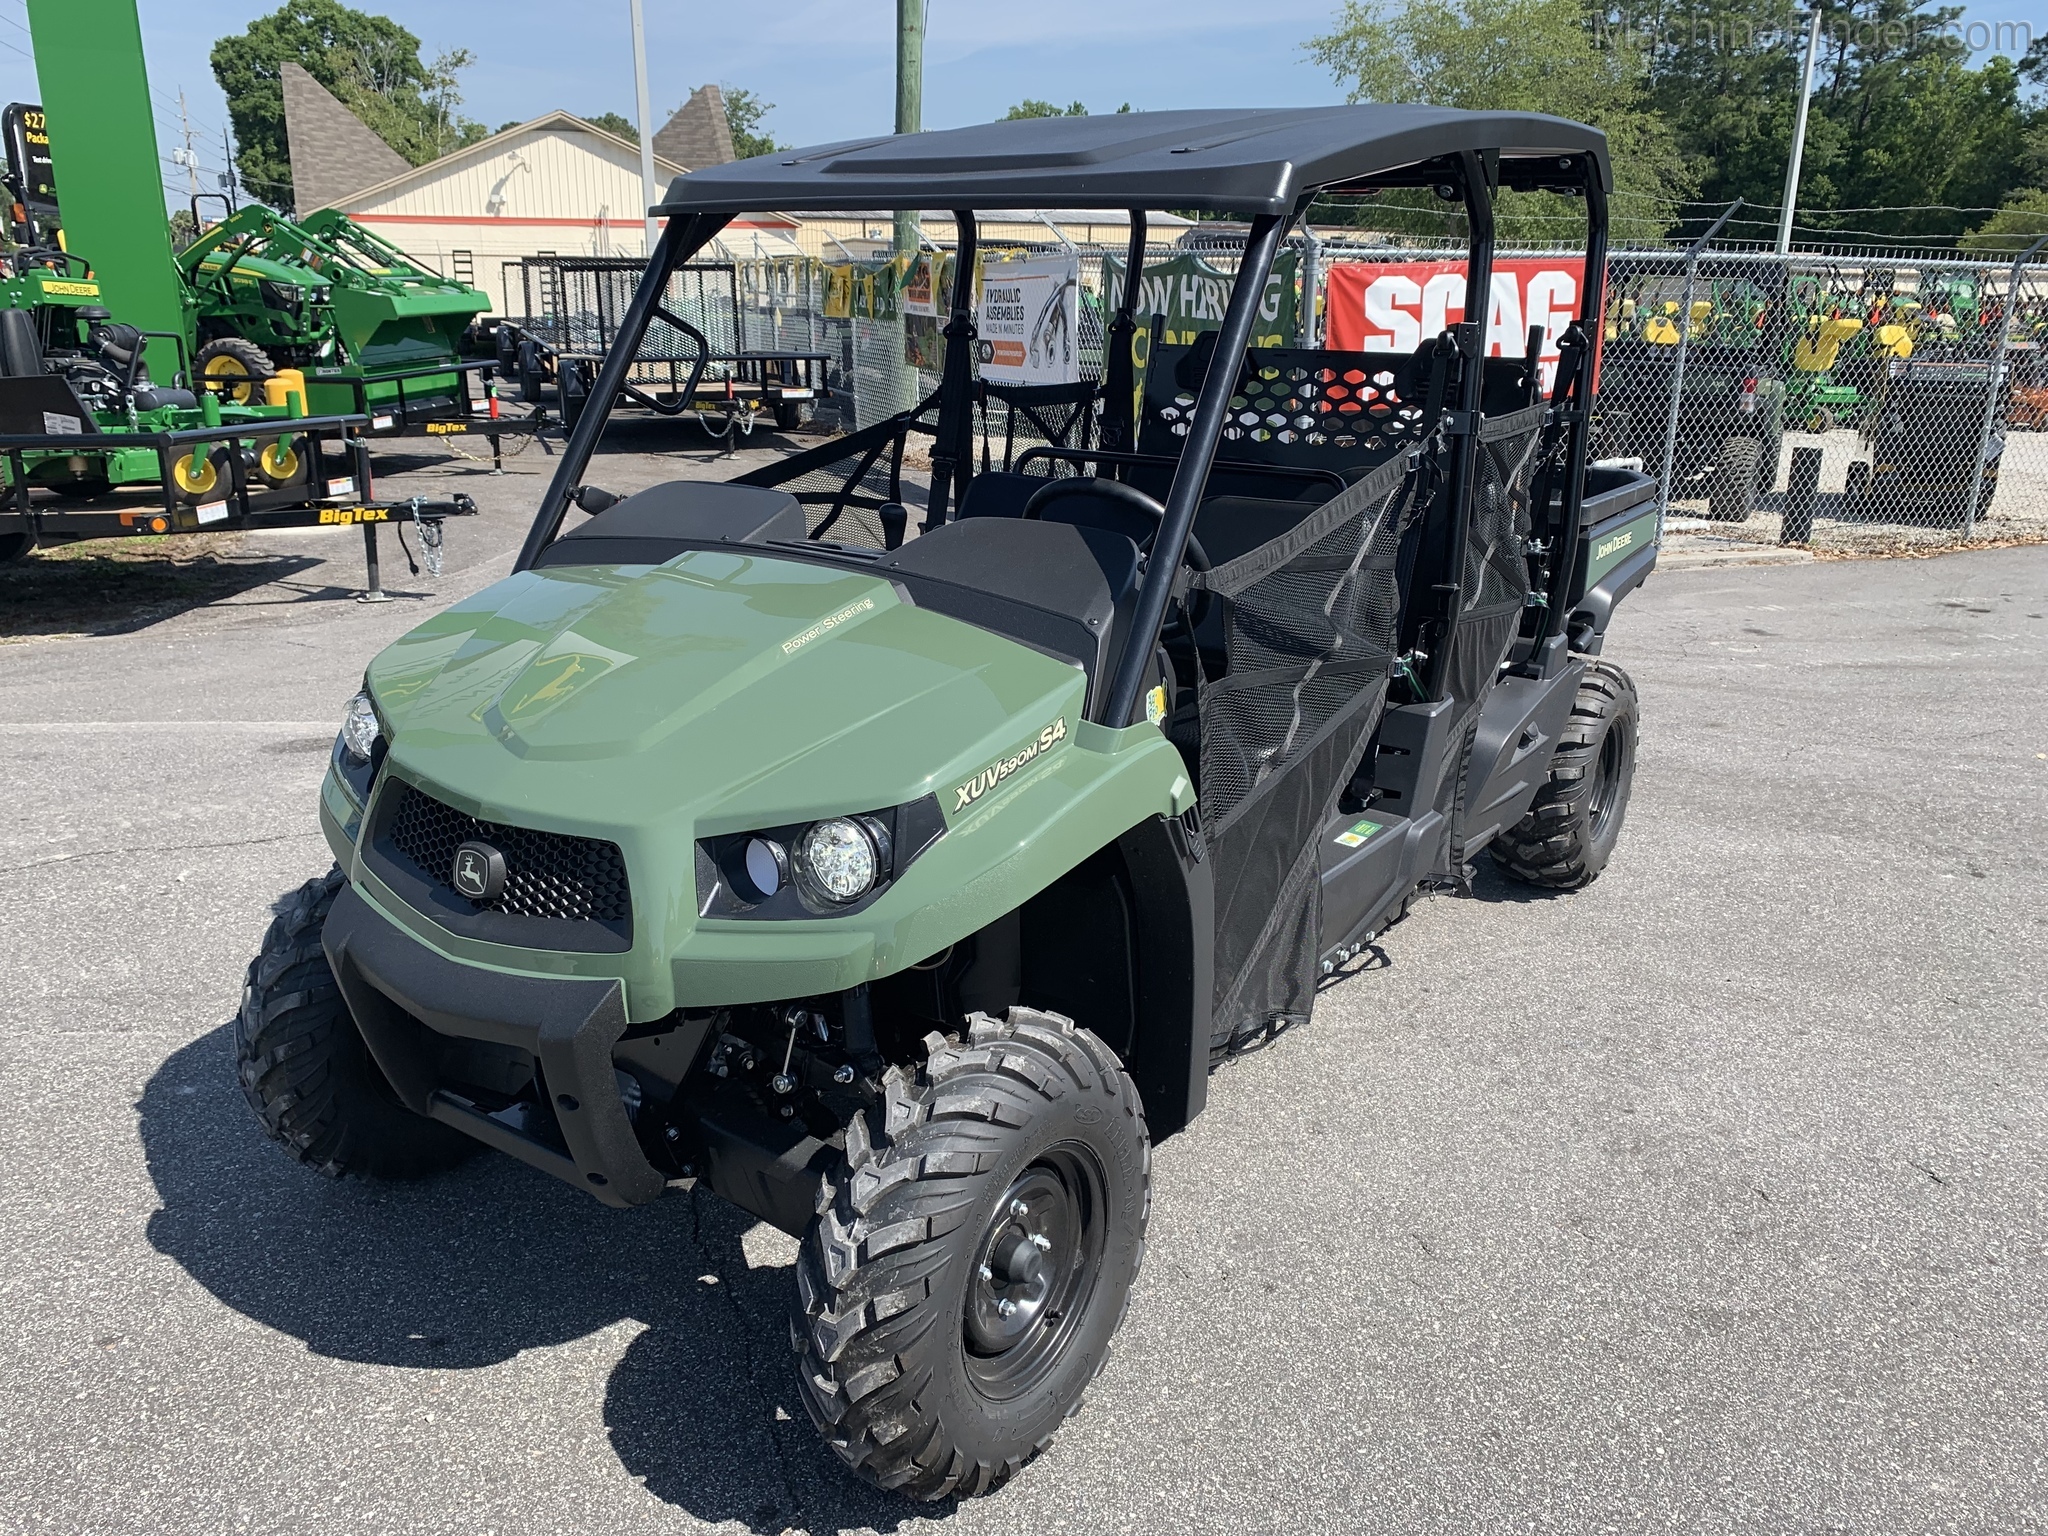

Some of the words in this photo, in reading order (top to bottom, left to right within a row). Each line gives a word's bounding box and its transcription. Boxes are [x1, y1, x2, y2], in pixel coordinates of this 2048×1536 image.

[51, 284, 69, 293] JOHN
[69, 284, 92, 295] DEERE
[985, 305, 1025, 321] ASSEMBLIES
[1363, 270, 1577, 358] SCAG
[985, 322, 998, 334] MADE
[1003, 323, 1025, 335] MINUTES
[426, 422, 468, 435] BigTex
[319, 507, 389, 526] BigTex
[1595, 541, 1613, 561] JOHN
[1612, 530, 1633, 552] DEERE
[781, 626, 821, 655] Power
[822, 597, 874, 630] Steering
[952, 739, 1039, 815] XUV590M
[1039, 715, 1067, 753] S4
